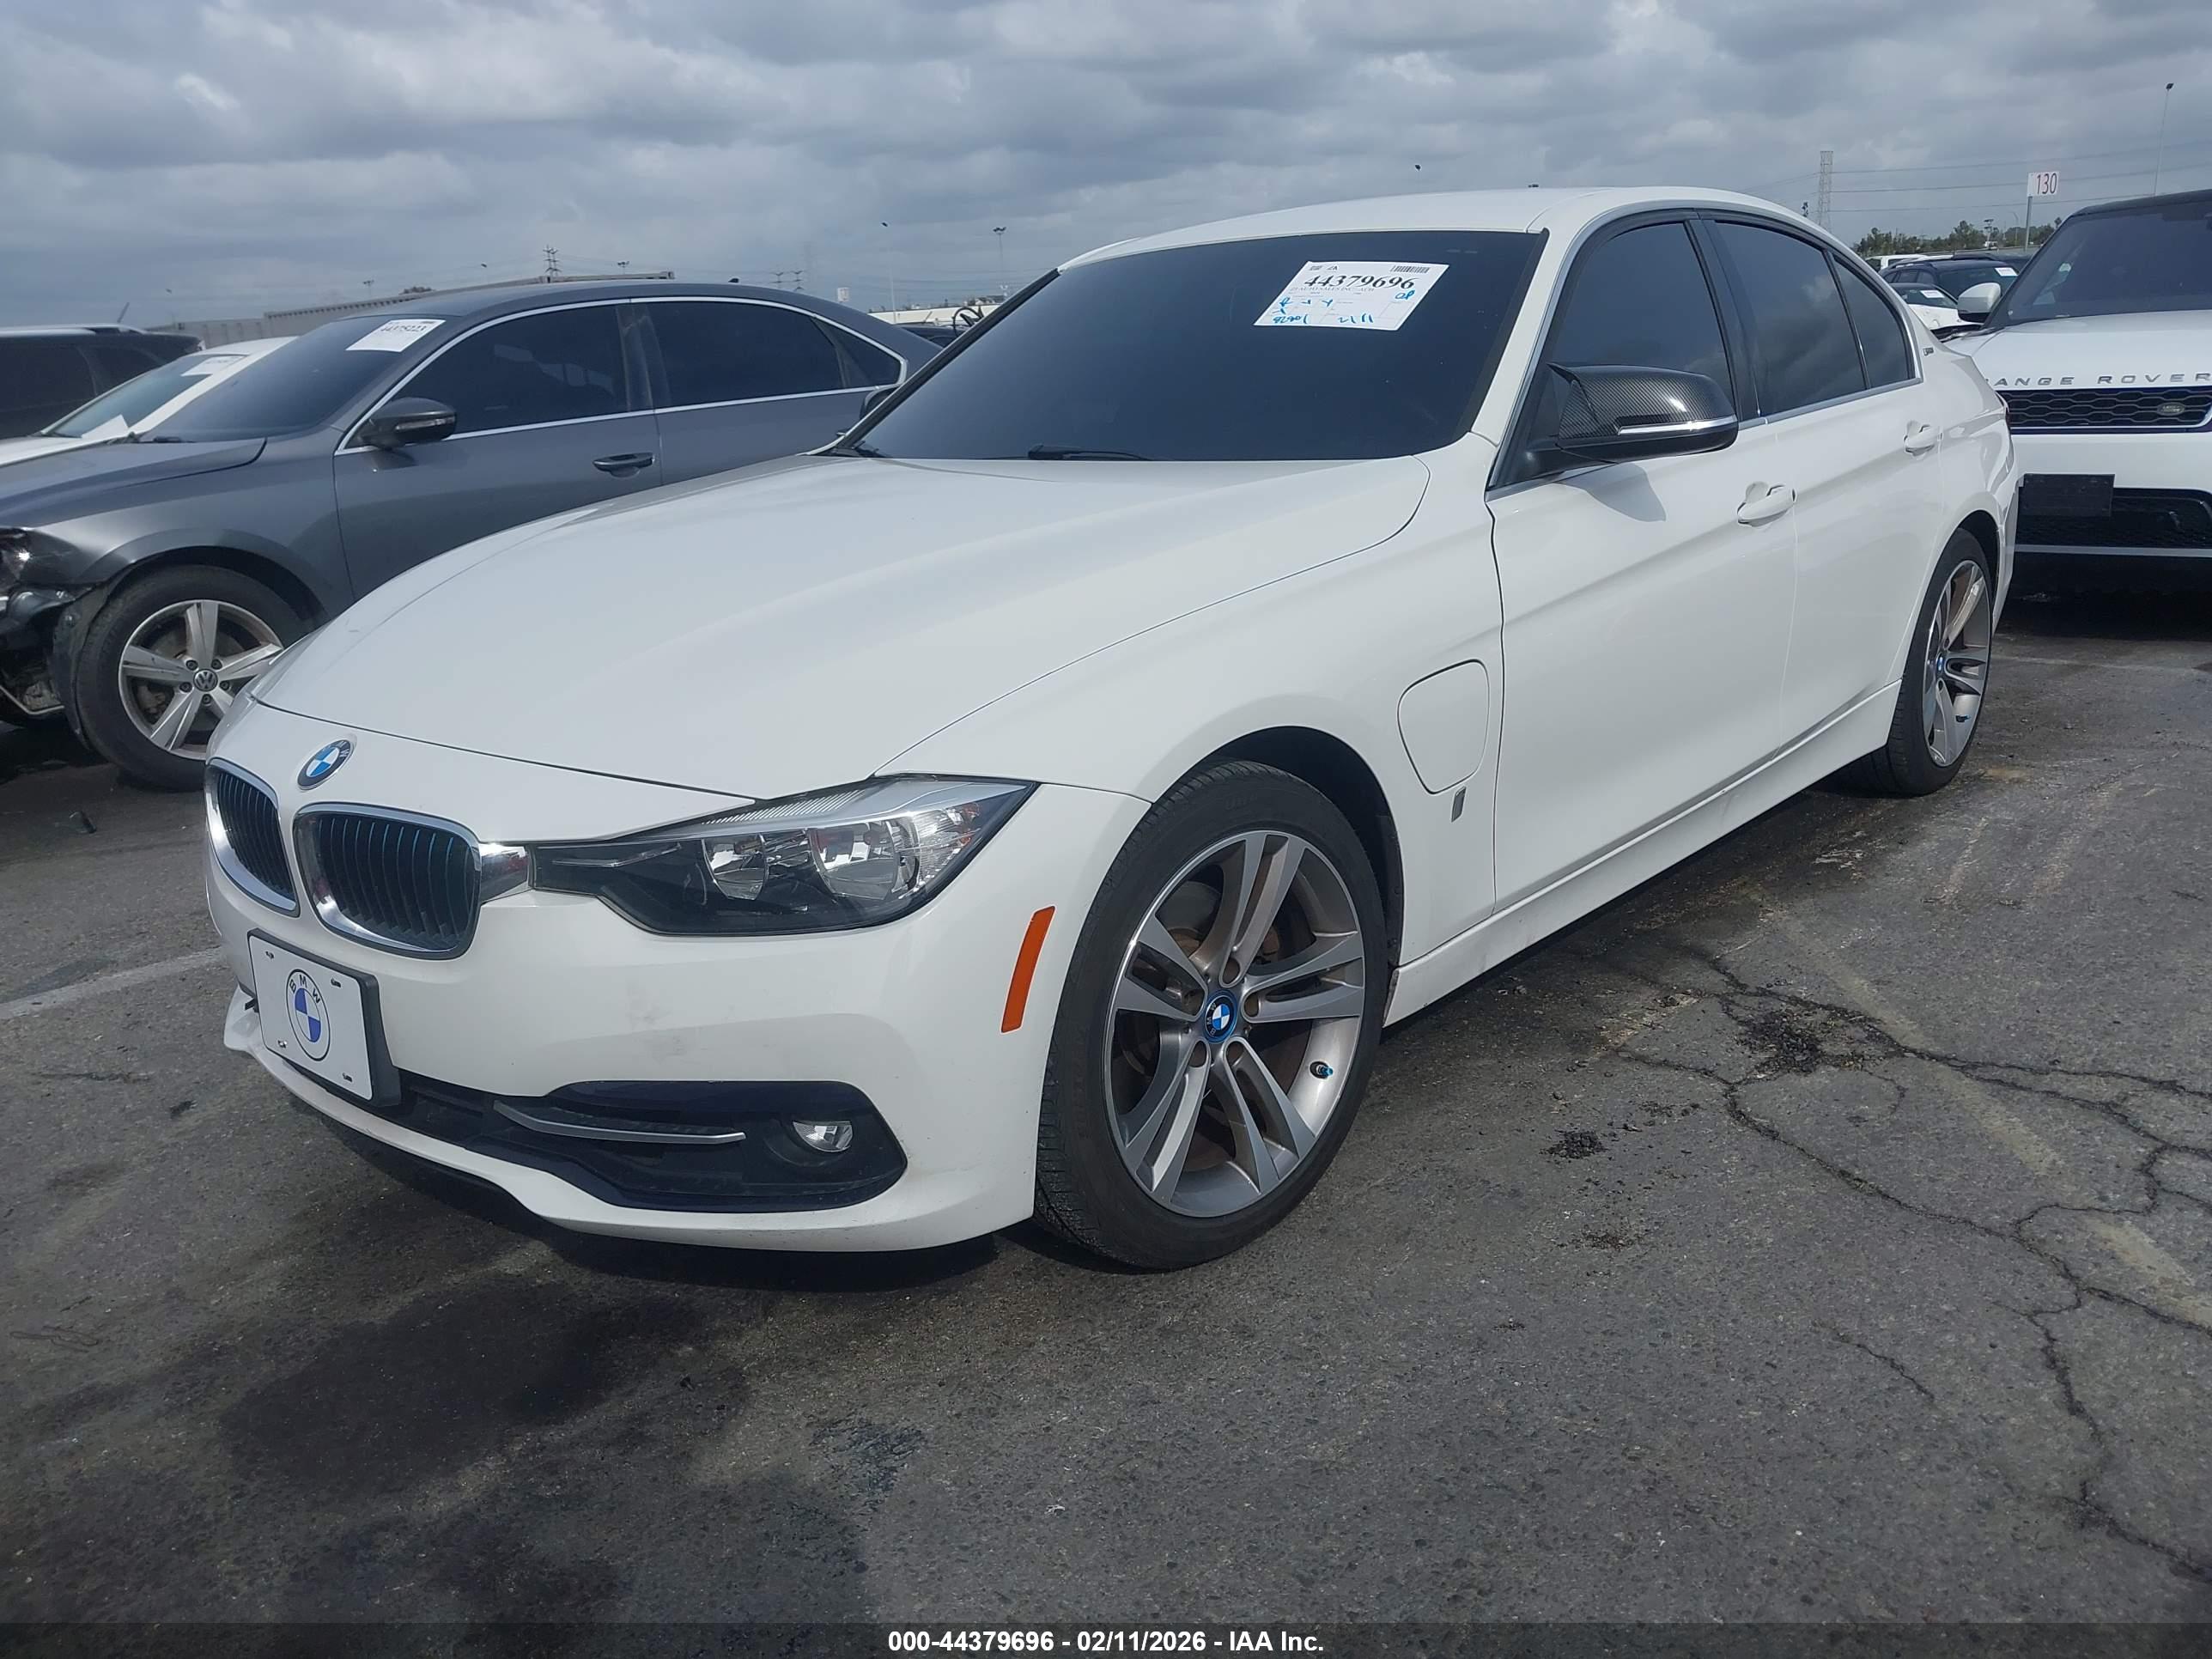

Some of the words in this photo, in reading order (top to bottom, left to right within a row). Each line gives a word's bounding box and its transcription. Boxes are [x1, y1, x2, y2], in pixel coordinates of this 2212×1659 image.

[2037, 173, 2057, 195] 130
[1304, 275, 1419, 289] 44379696
[1986, 376, 2075, 386] ANGE
[2097, 373, 2212, 384] ROVER
[289, 975, 320, 1004] BMW
